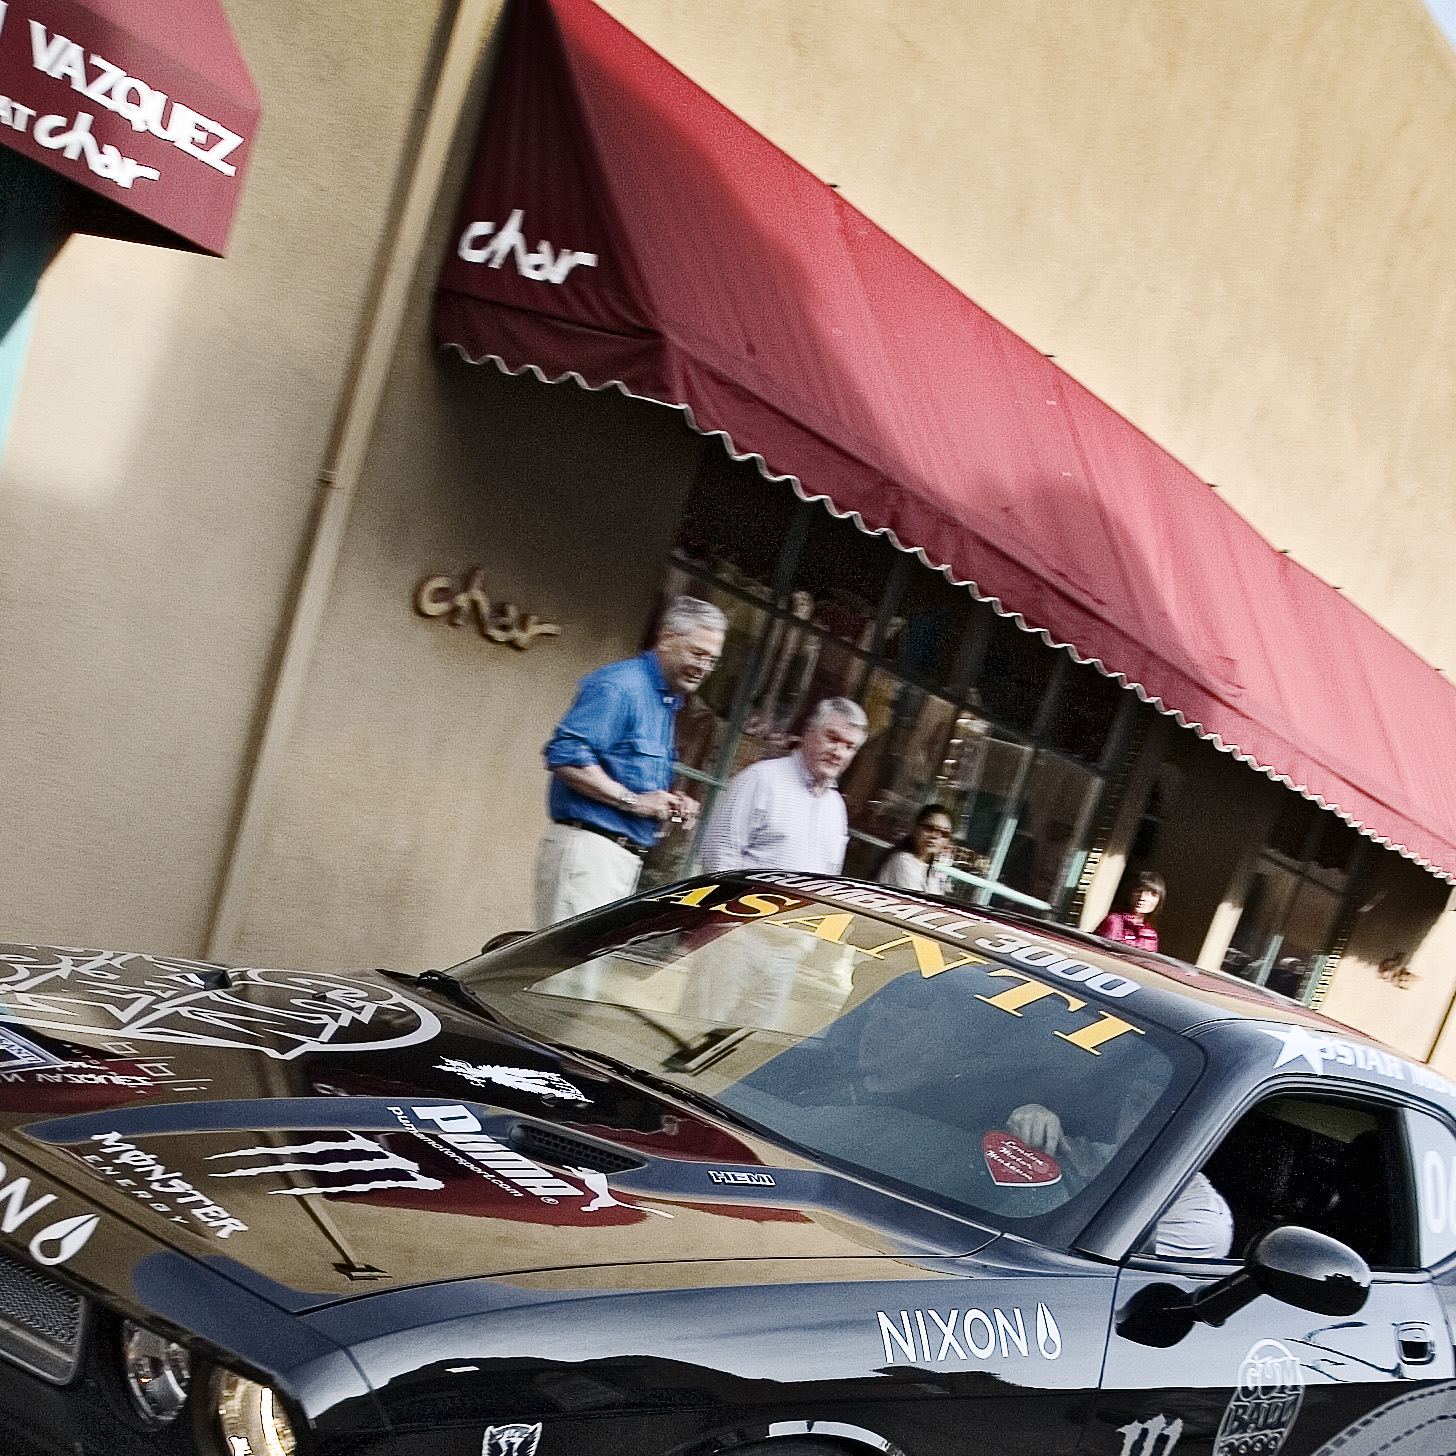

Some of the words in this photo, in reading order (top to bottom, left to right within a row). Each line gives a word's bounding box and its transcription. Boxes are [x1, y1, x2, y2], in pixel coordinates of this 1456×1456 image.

[29, 19, 244, 177] VAZQUEZ
[33, 111, 161, 189] char
[458, 209, 599, 285] char
[414, 566, 561, 652] char
[644, 884, 1146, 1056] ASANTI
[746, 870, 968, 939] GUMBALL
[974, 932, 1141, 998] 3000
[82, 1154, 190, 1224] ENERGY
[386, 1106, 525, 1198] pumamotorsport.com
[707, 1170, 777, 1187] HEMI
[876, 1307, 1030, 1364] NIXON
